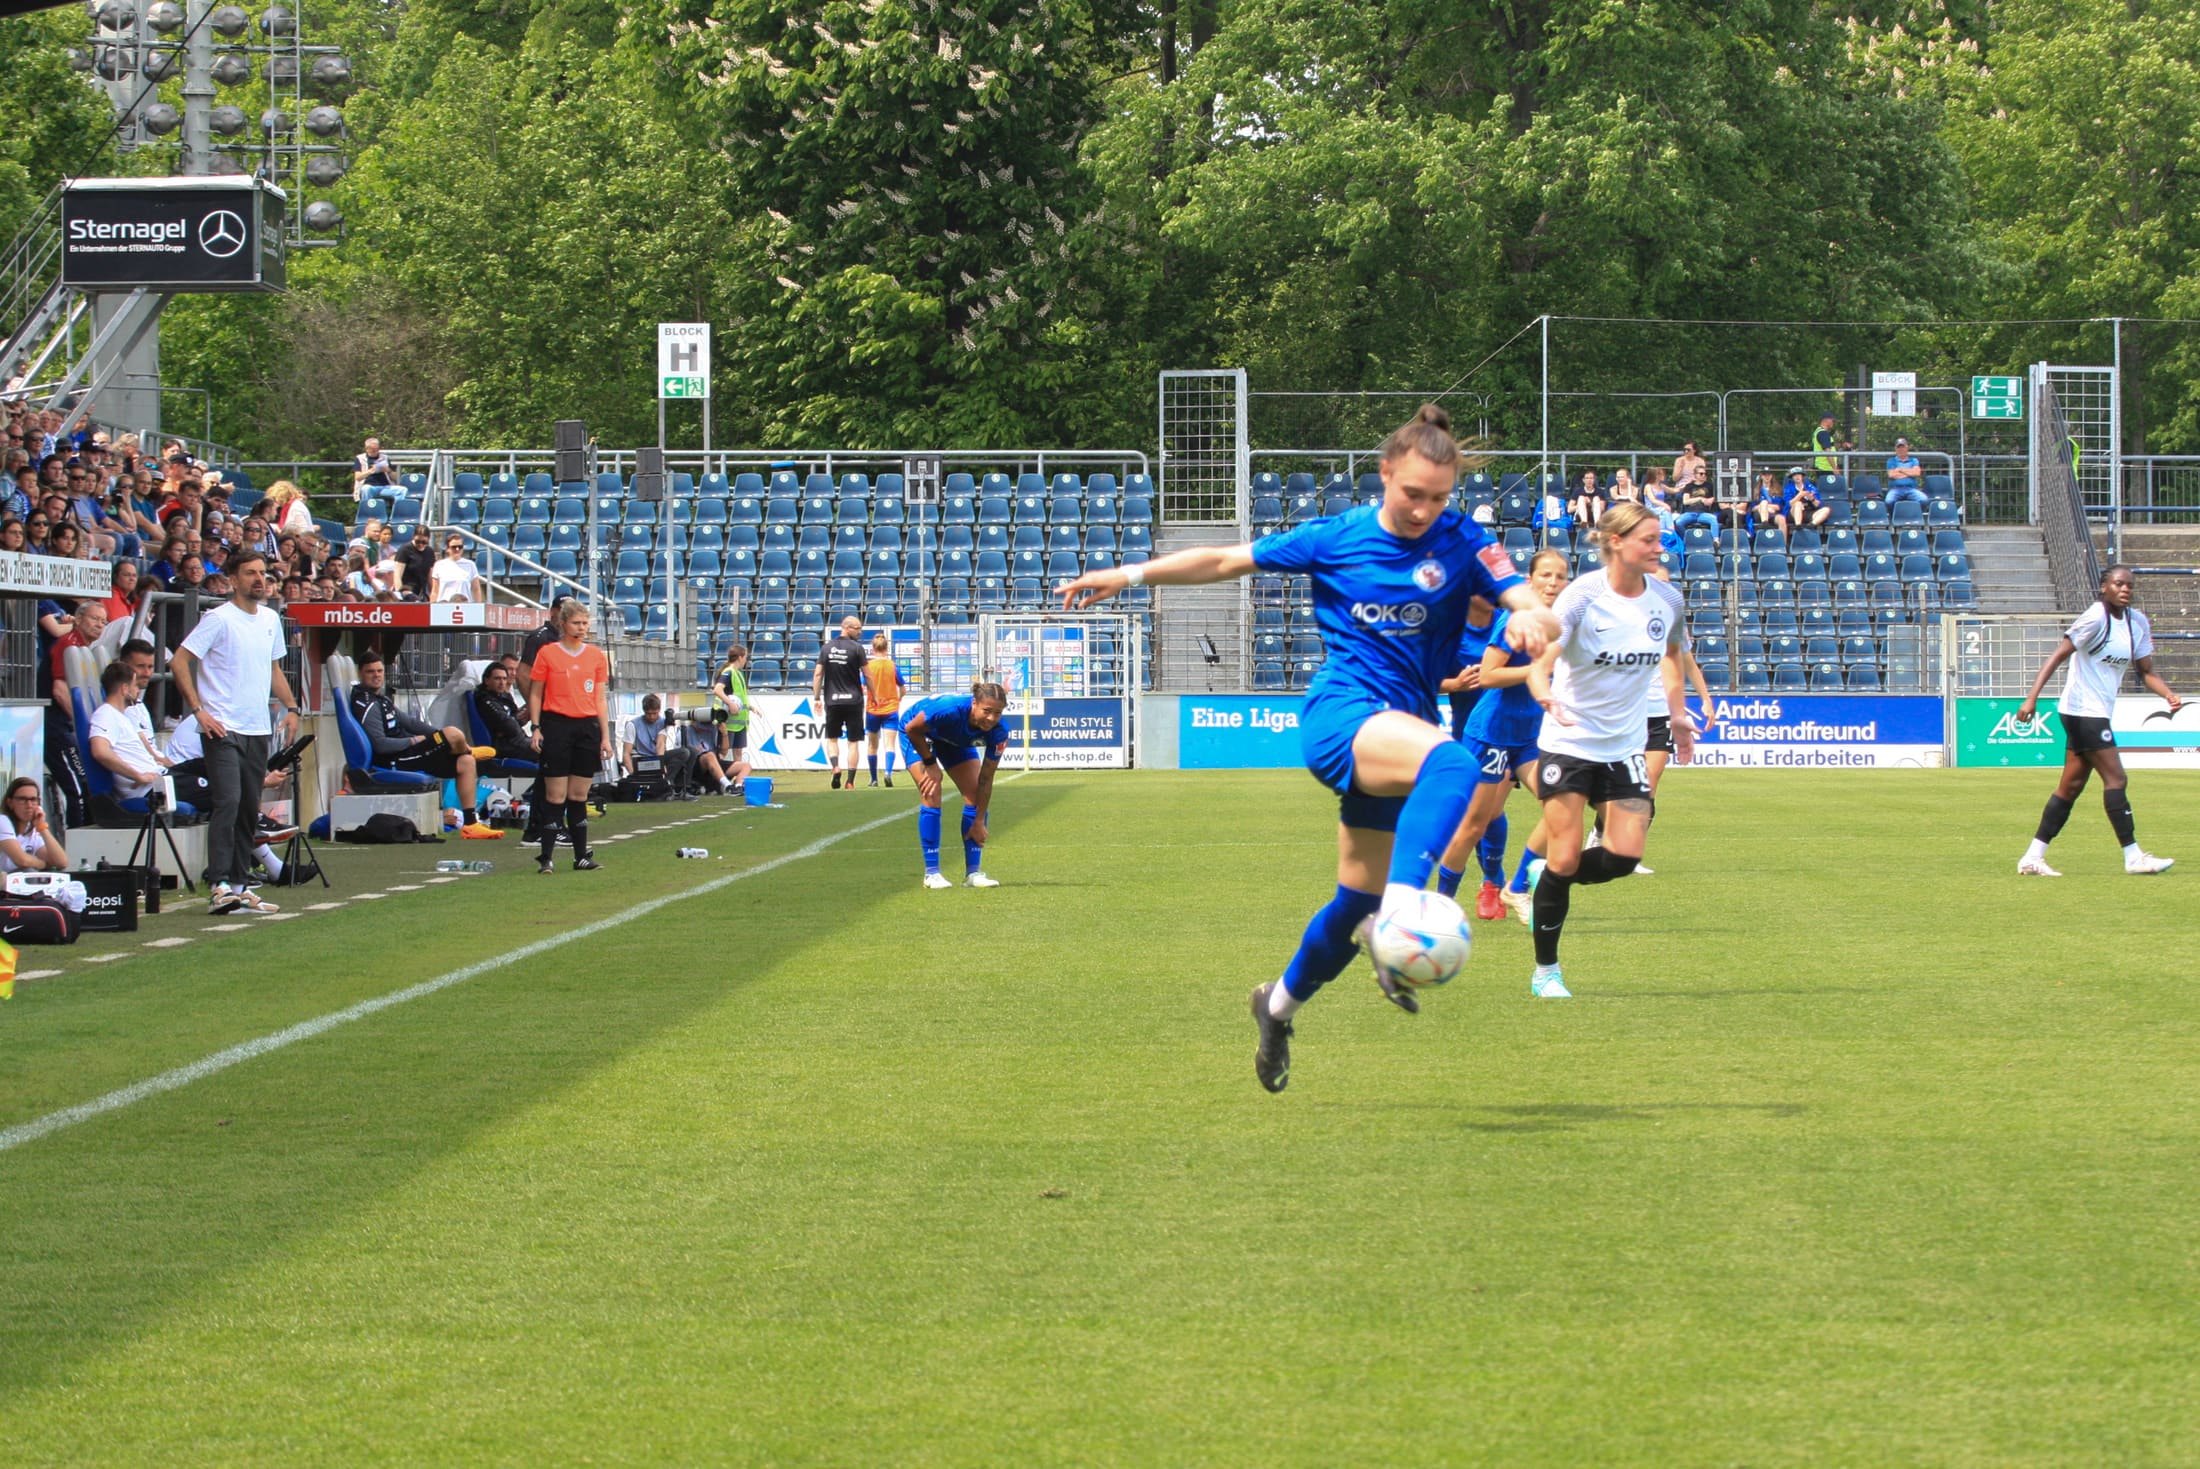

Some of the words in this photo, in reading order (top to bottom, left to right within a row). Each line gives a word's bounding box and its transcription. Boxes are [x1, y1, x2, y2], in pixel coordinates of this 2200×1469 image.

[69, 218, 186, 243] Sternagel
[80, 244, 117, 252] Unternehmen
[664, 327, 704, 336] BLOCK
[670, 343, 698, 371] H
[1878, 376, 1911, 384] BLOCK
[49, 563, 75, 587] DRUCKEN
[324, 606, 393, 625] mbs.de
[1966, 632, 1980, 653] 2
[1616, 652, 1661, 665] LOTTO
[1017, 702, 1038, 711] PH
[1715, 700, 1781, 720] André
[1051, 717, 1078, 728] DEIN
[1081, 717, 1113, 728] STYLE
[1191, 707, 1243, 728] Eine
[1249, 707, 1299, 733] Liga
[1989, 711, 2054, 737] AOK
[782, 723, 826, 740] FSM
[1041, 729, 1113, 740] WORKWEAR
[1715, 720, 1875, 741] Tausendfreund
[1481, 748, 1508, 775] 20
[1740, 752, 1757, 765] u.
[1764, 750, 1875, 765] Erdarbeiten
